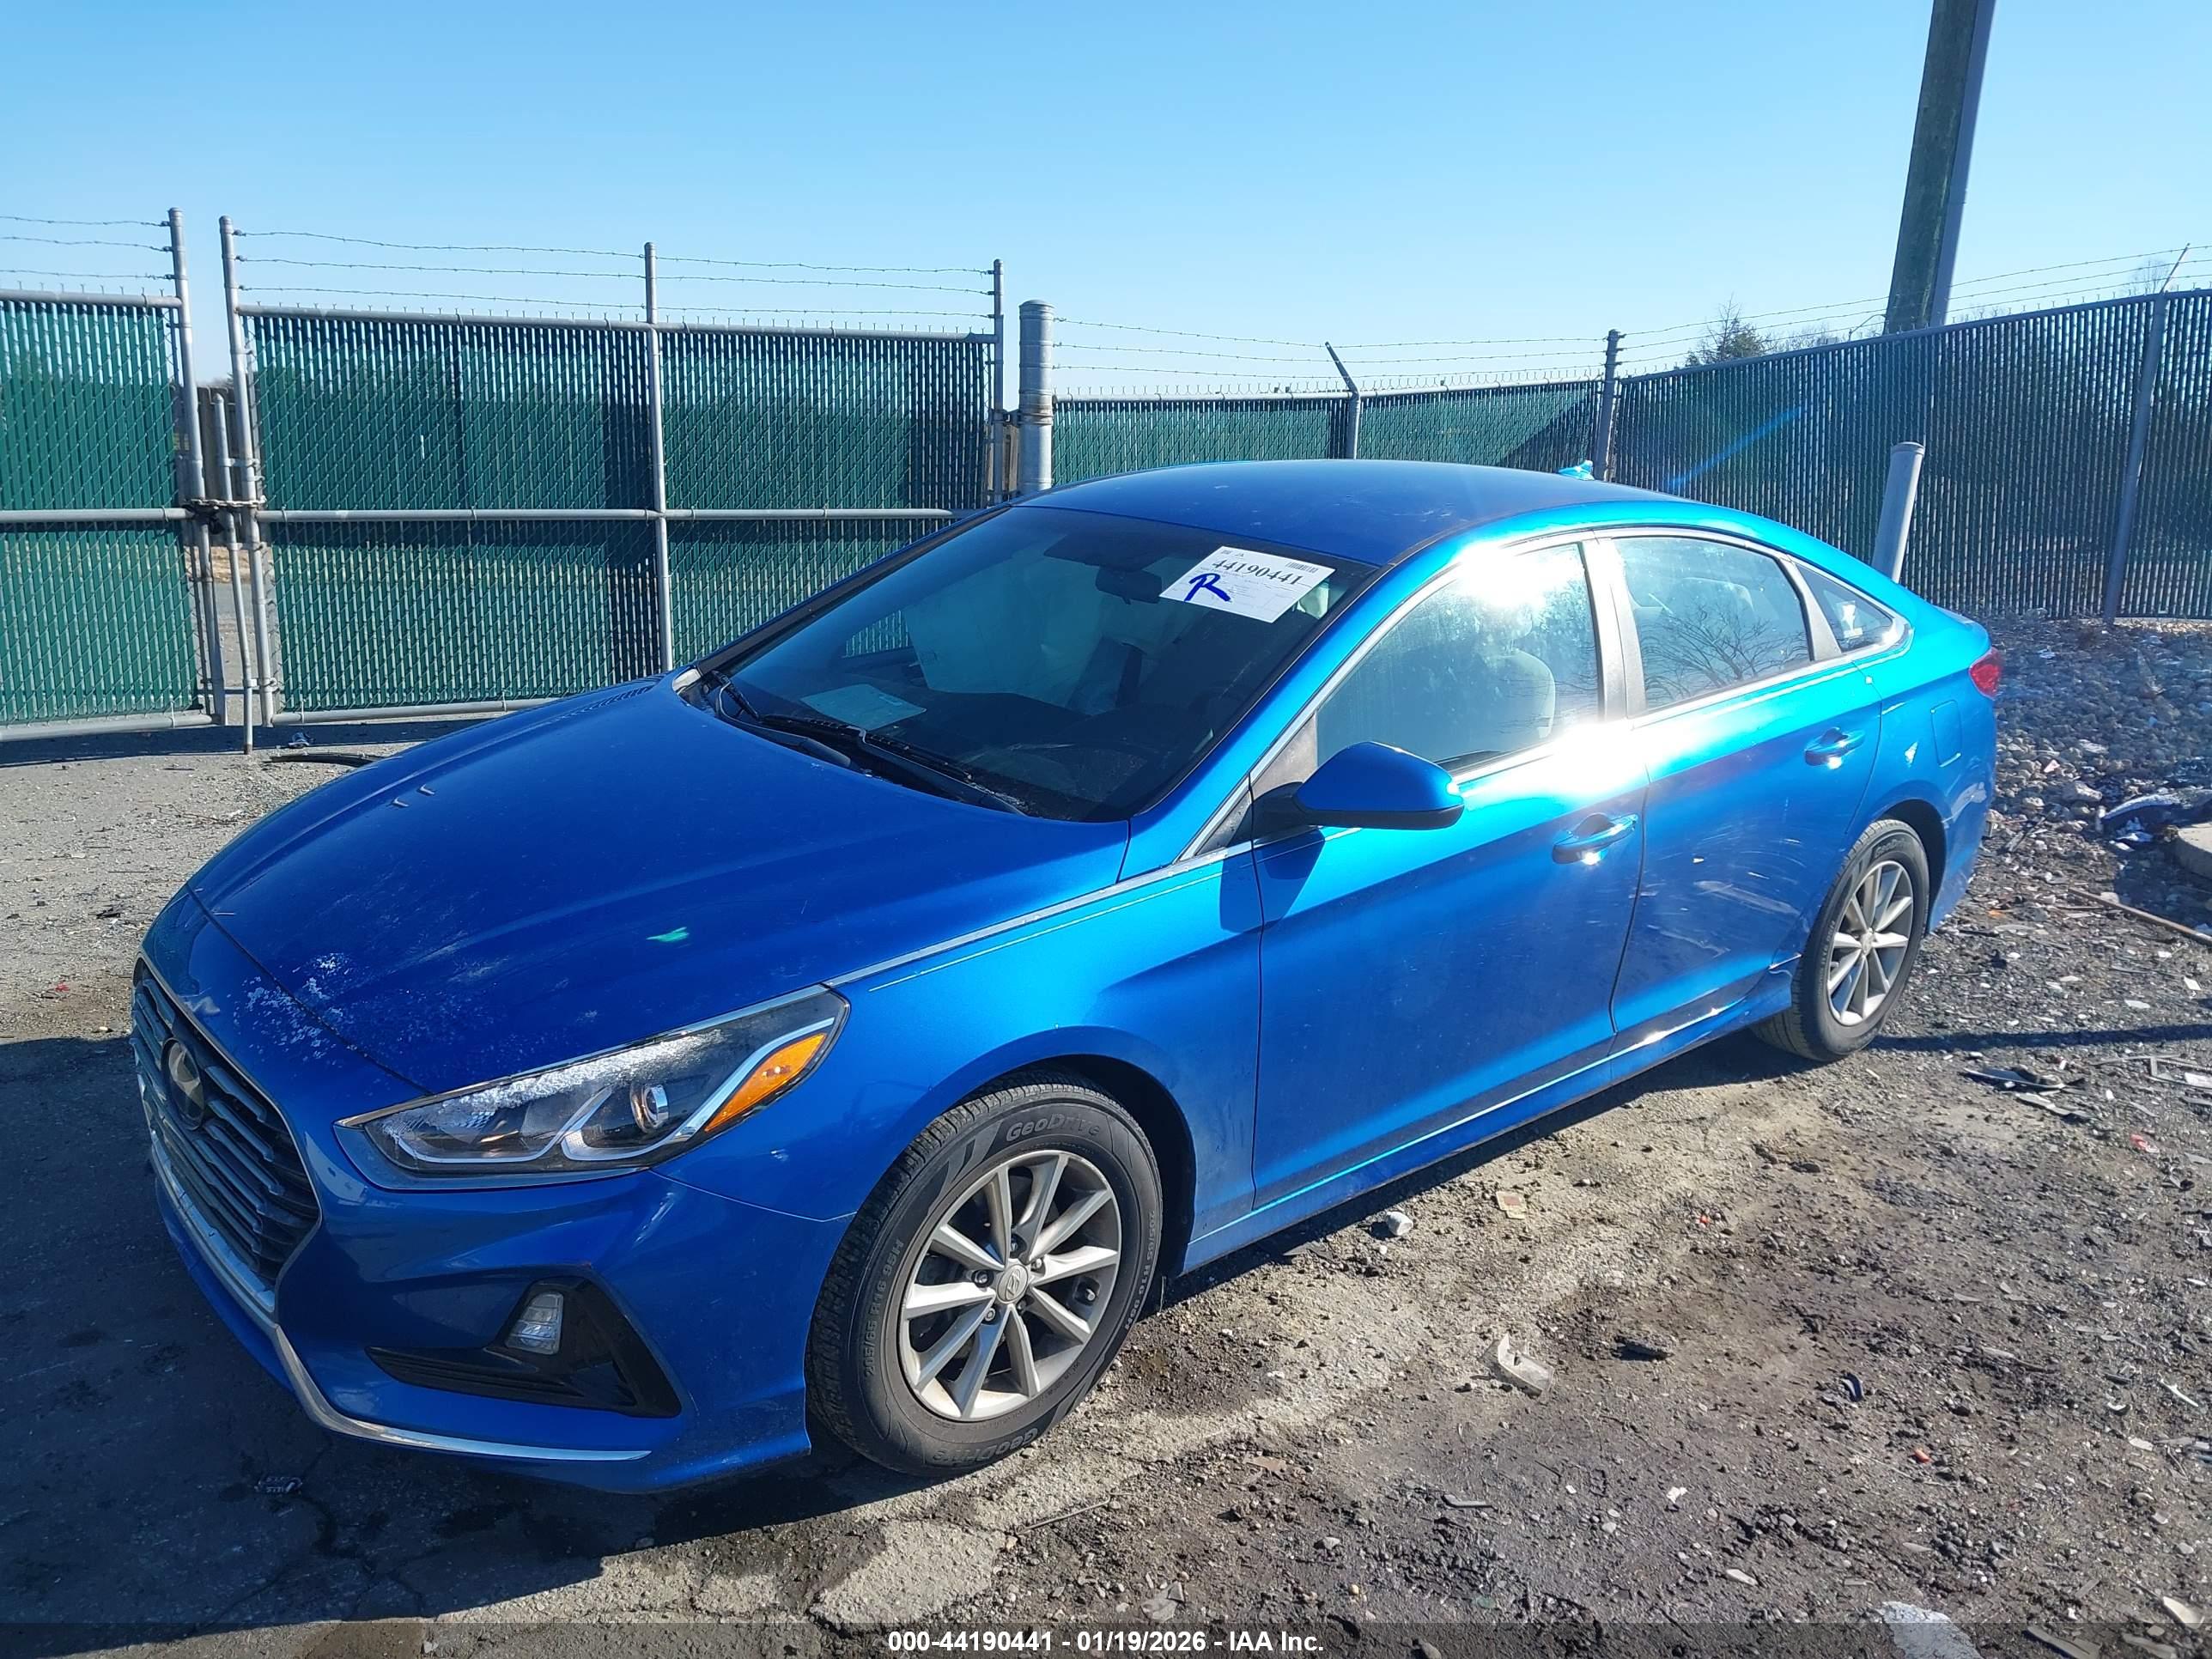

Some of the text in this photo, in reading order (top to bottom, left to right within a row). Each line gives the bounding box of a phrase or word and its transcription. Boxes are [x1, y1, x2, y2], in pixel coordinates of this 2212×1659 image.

[1184, 572, 1231, 602] R
[1212, 559, 1304, 585] 44190441
[1006, 1114, 1101, 1142] GeoDrive
[870, 1279, 887, 1315] R16
[864, 1320, 878, 1377] 205/65
